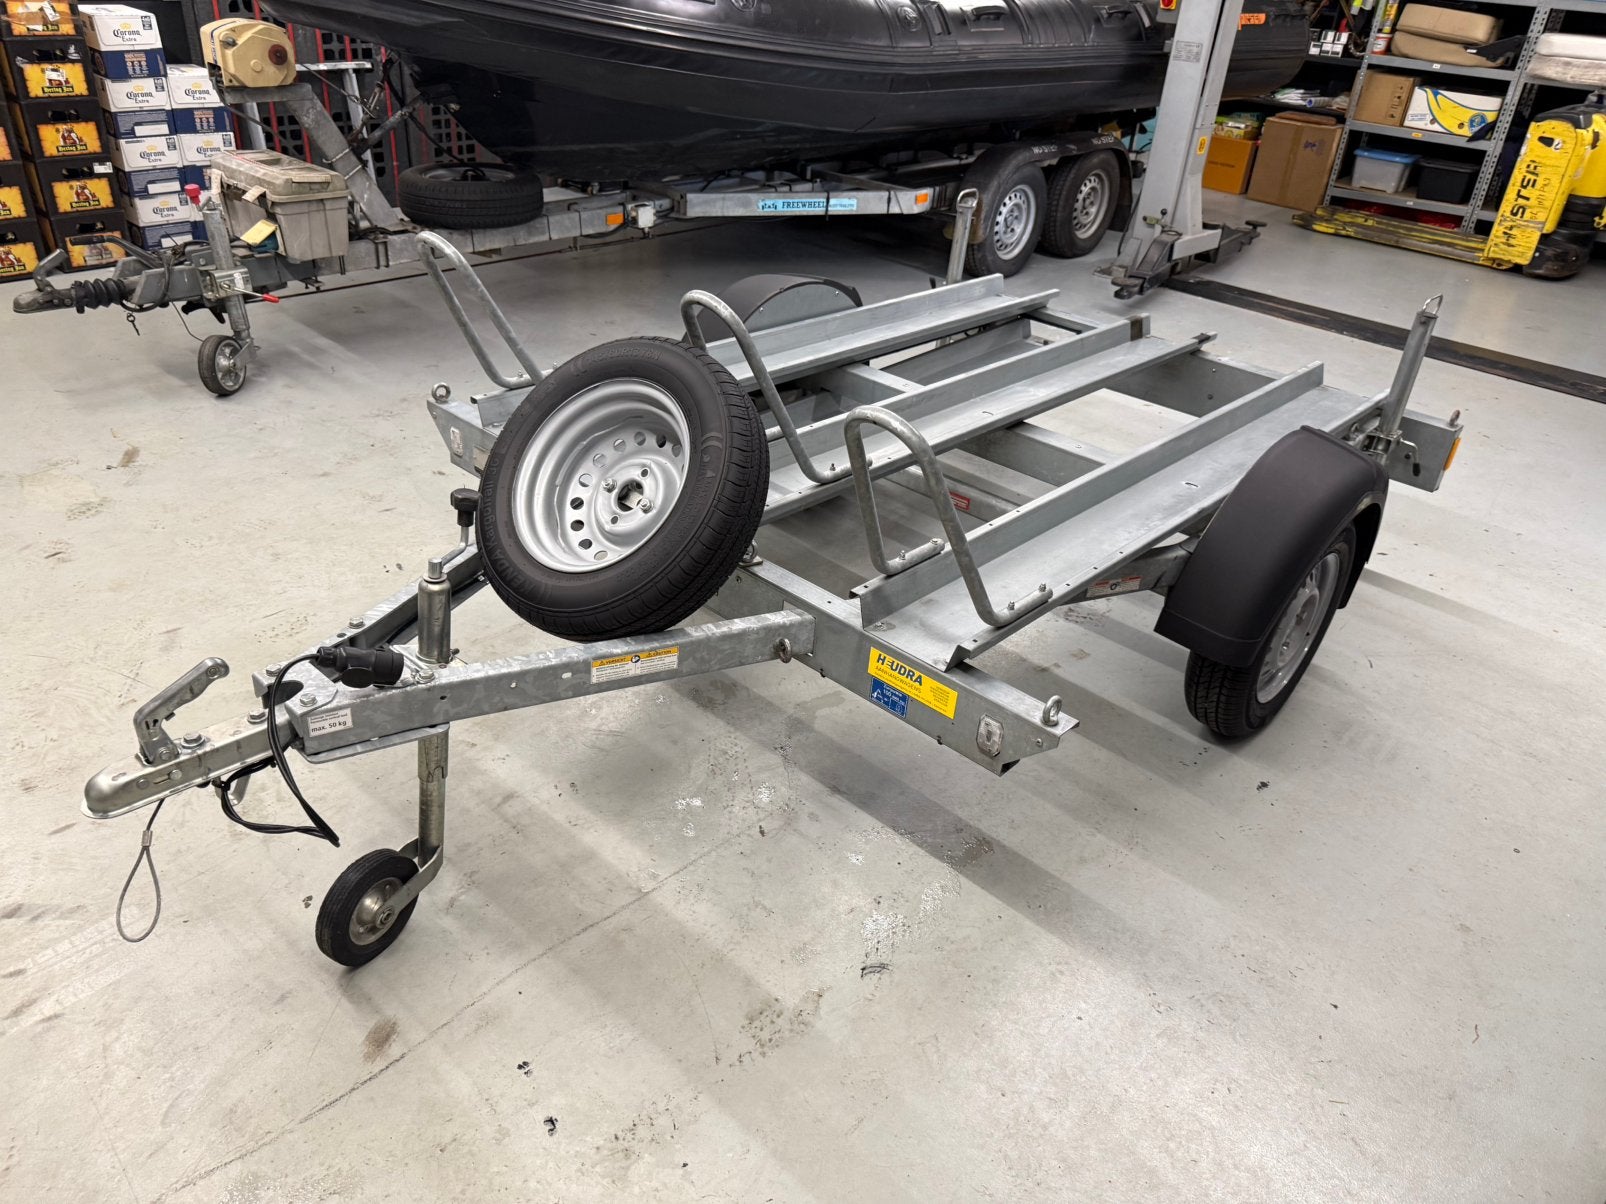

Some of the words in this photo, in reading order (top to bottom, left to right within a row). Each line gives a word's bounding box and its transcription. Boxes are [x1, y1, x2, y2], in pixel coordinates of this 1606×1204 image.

[113, 29, 142, 38] Corona
[126, 90, 155, 100] Corona
[185, 88, 211, 97] Corona
[140, 150, 166, 159] Corona
[196, 146, 221, 154] Corona
[153, 206, 178, 215] Corona
[877, 653, 923, 687] HEUDRA
